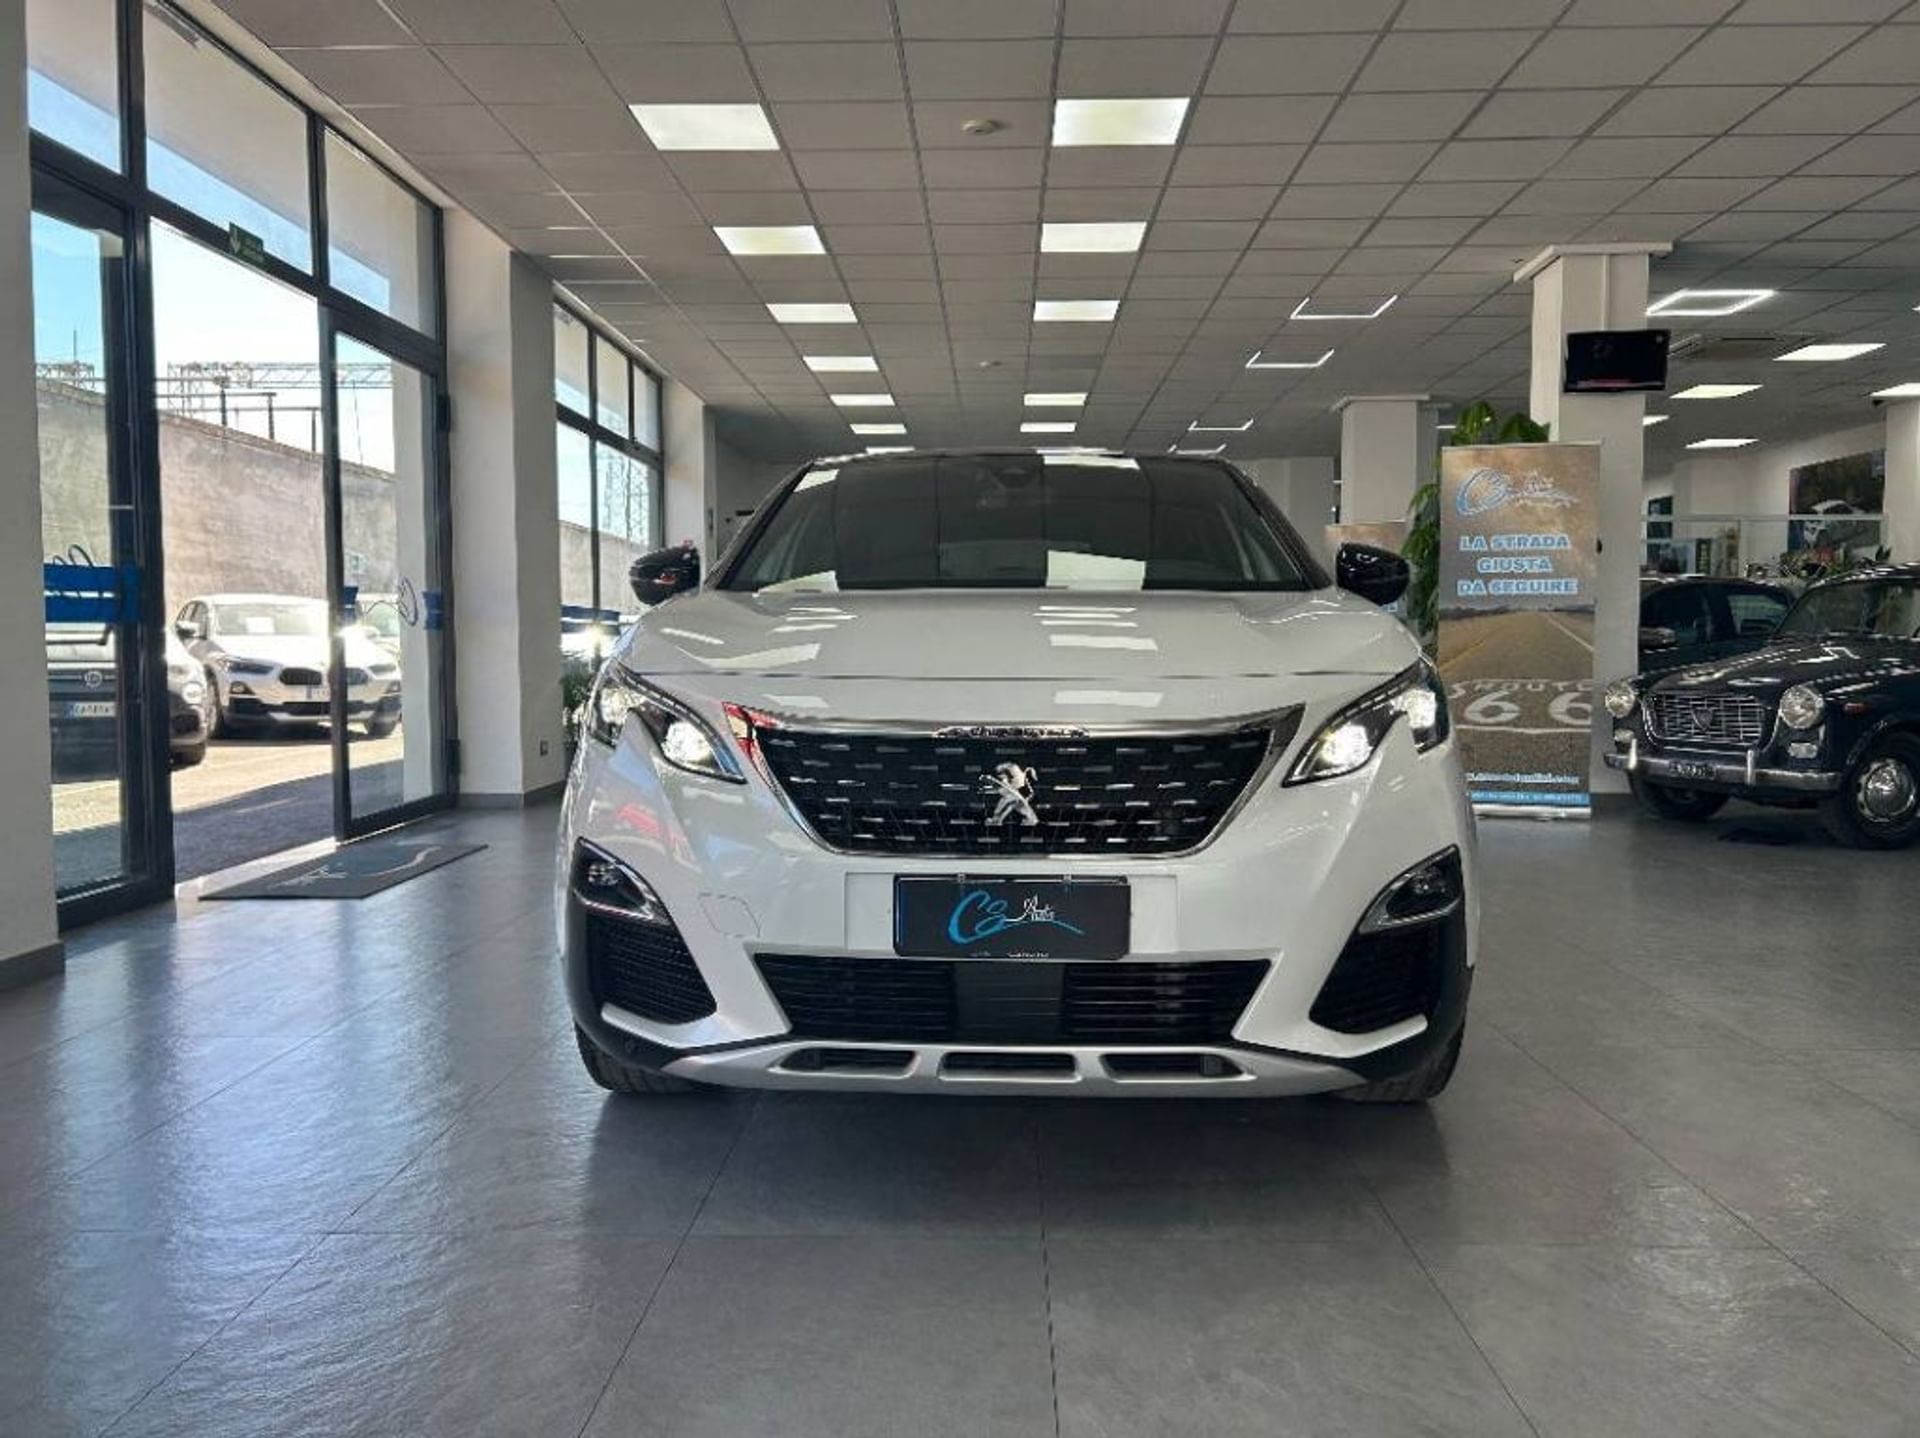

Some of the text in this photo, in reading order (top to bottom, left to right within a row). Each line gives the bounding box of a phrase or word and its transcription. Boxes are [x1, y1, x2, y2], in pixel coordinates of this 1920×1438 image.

[1460, 534, 1571, 550] LA STRADA
[1477, 556, 1552, 573] GIUSTA
[1457, 578, 1578, 595] DA SEGUIRE
[1465, 690, 1592, 725] 66
